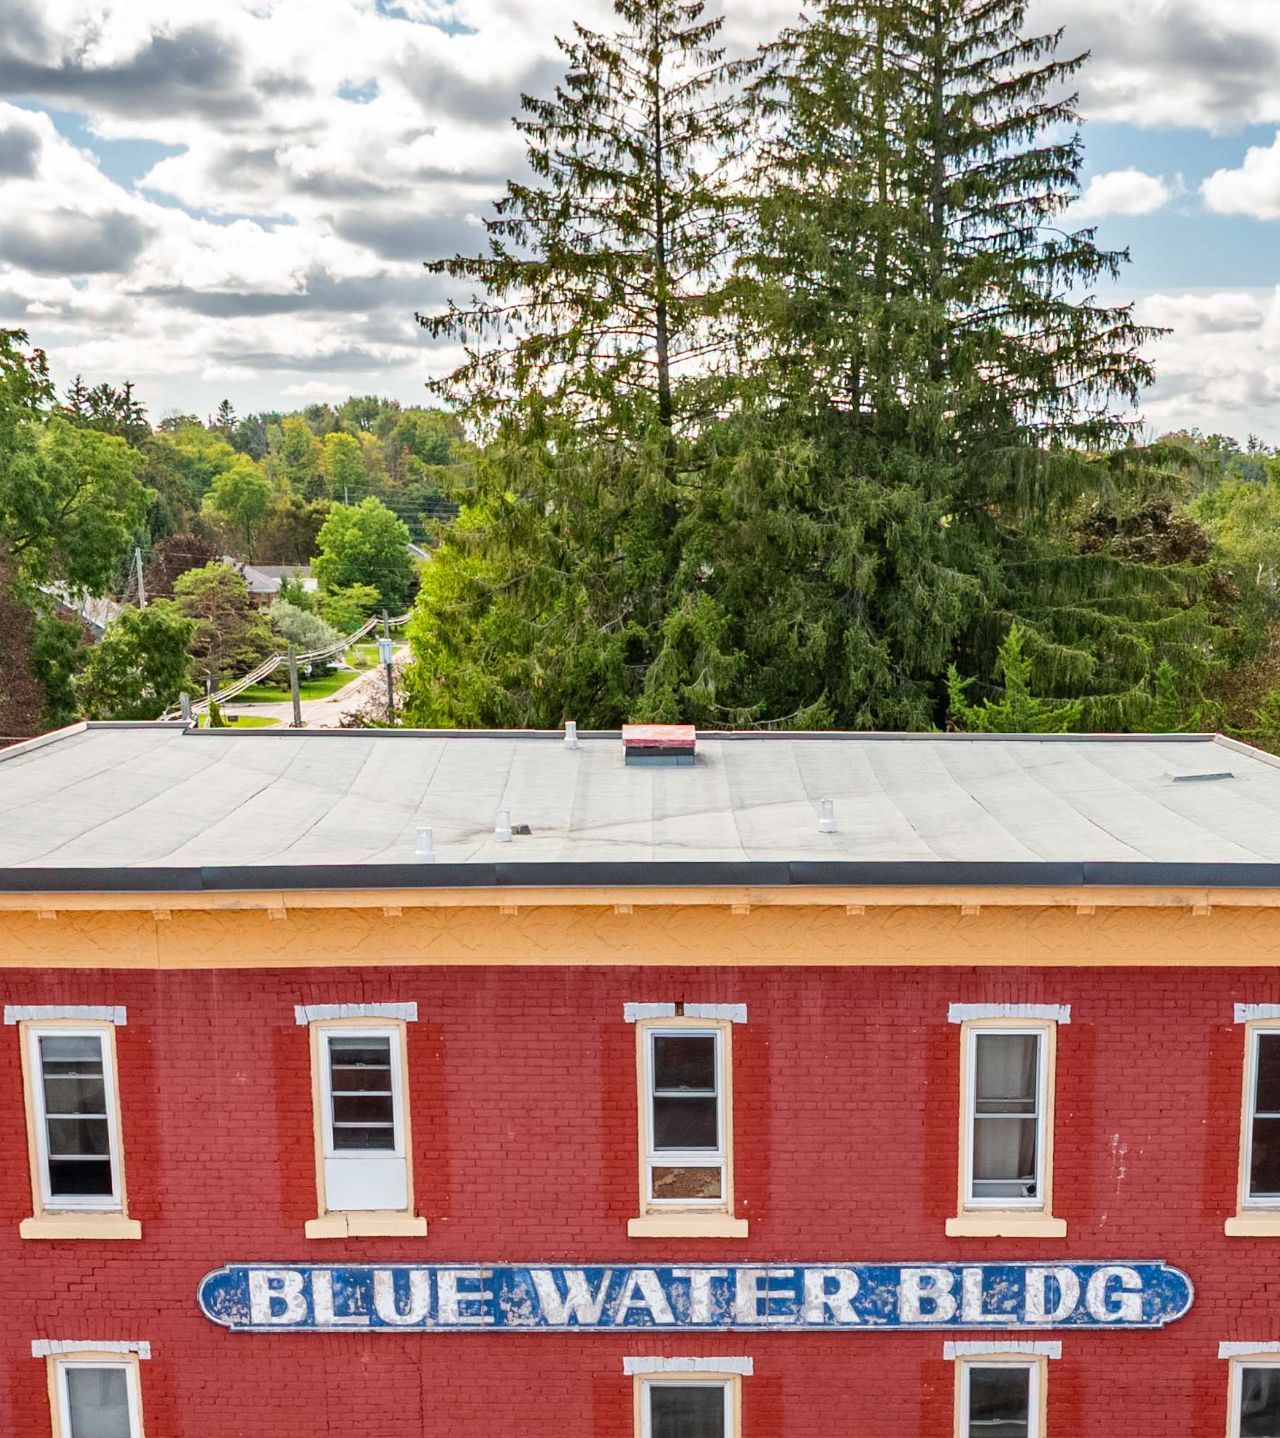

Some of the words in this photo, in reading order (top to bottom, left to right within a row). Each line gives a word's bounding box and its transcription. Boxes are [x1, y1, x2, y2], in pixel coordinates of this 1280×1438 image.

[248, 1269, 494, 1325] BLUE
[529, 1267, 861, 1325] WATER
[899, 1266, 1144, 1322] BLDG
